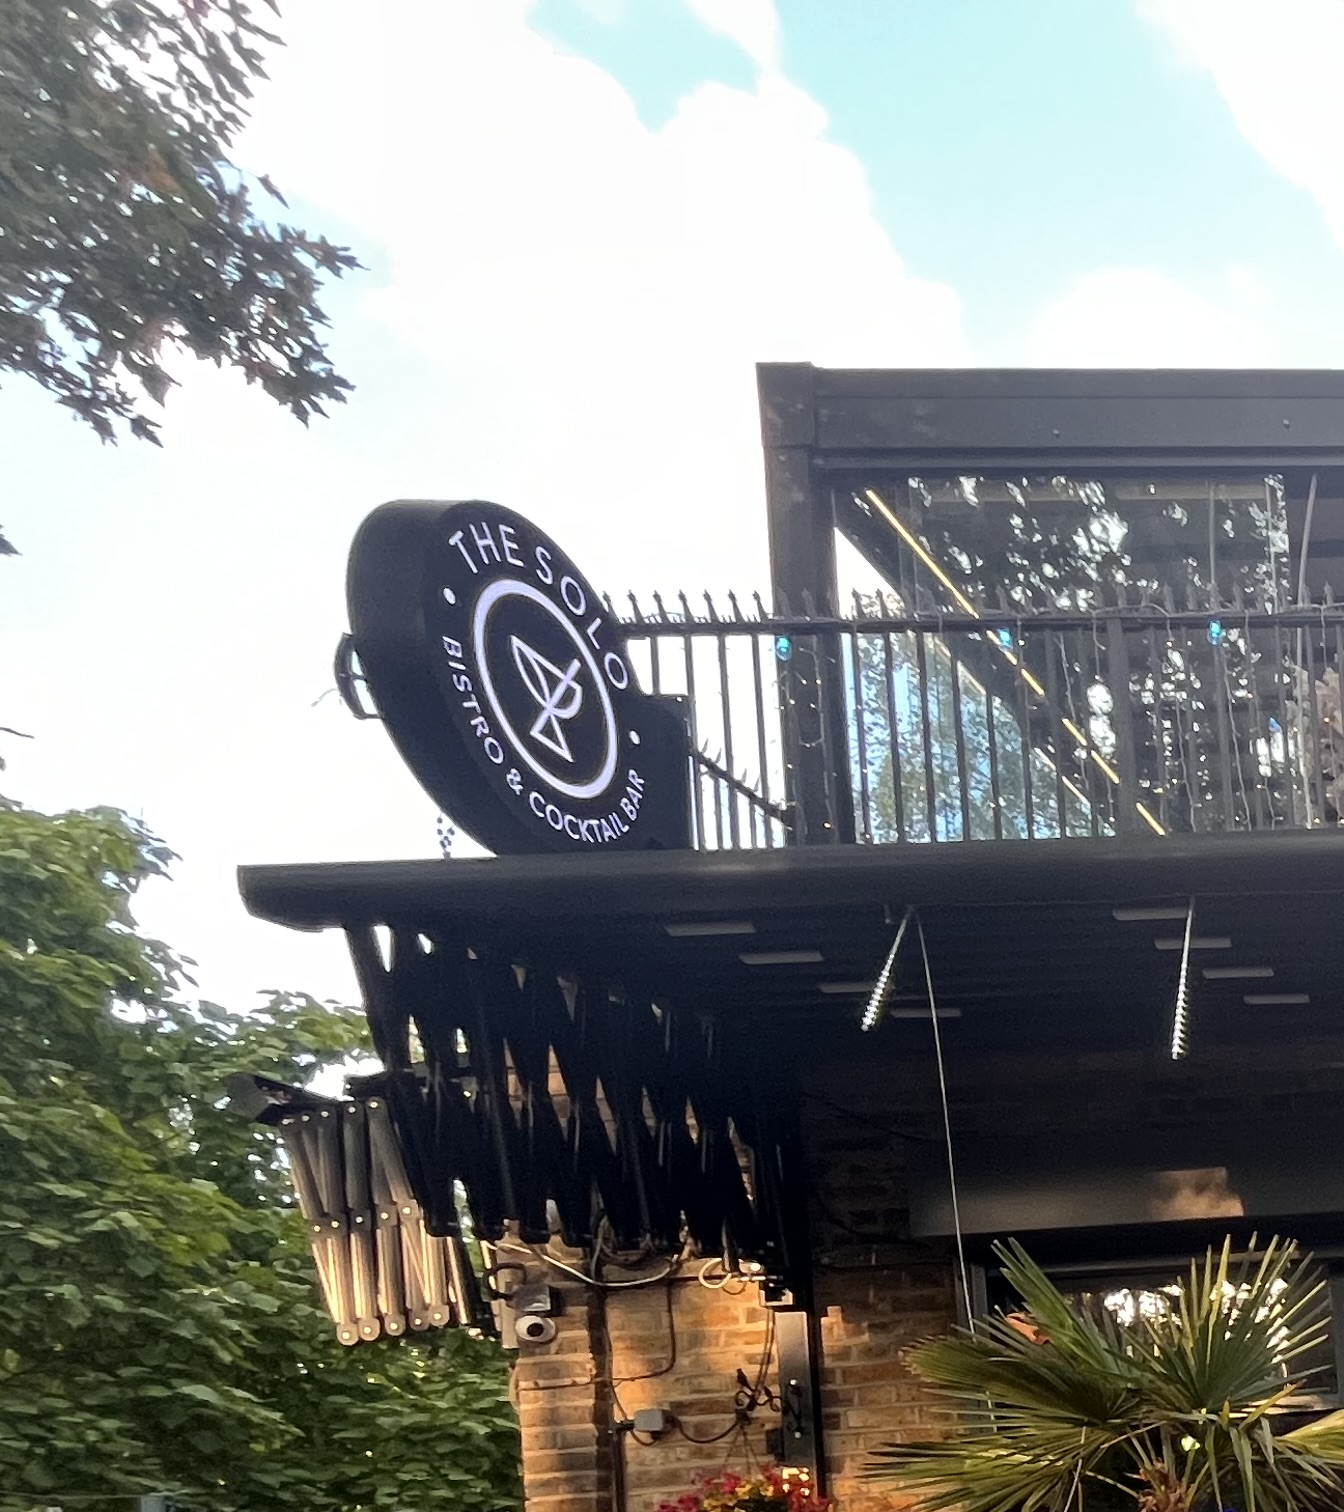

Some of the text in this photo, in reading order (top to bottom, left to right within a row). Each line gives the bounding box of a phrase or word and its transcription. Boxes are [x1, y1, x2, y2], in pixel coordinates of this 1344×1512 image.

[448, 522, 629, 690] THE SOLO
[442, 635, 645, 844] BISTRO & COCKTAIL BAR
